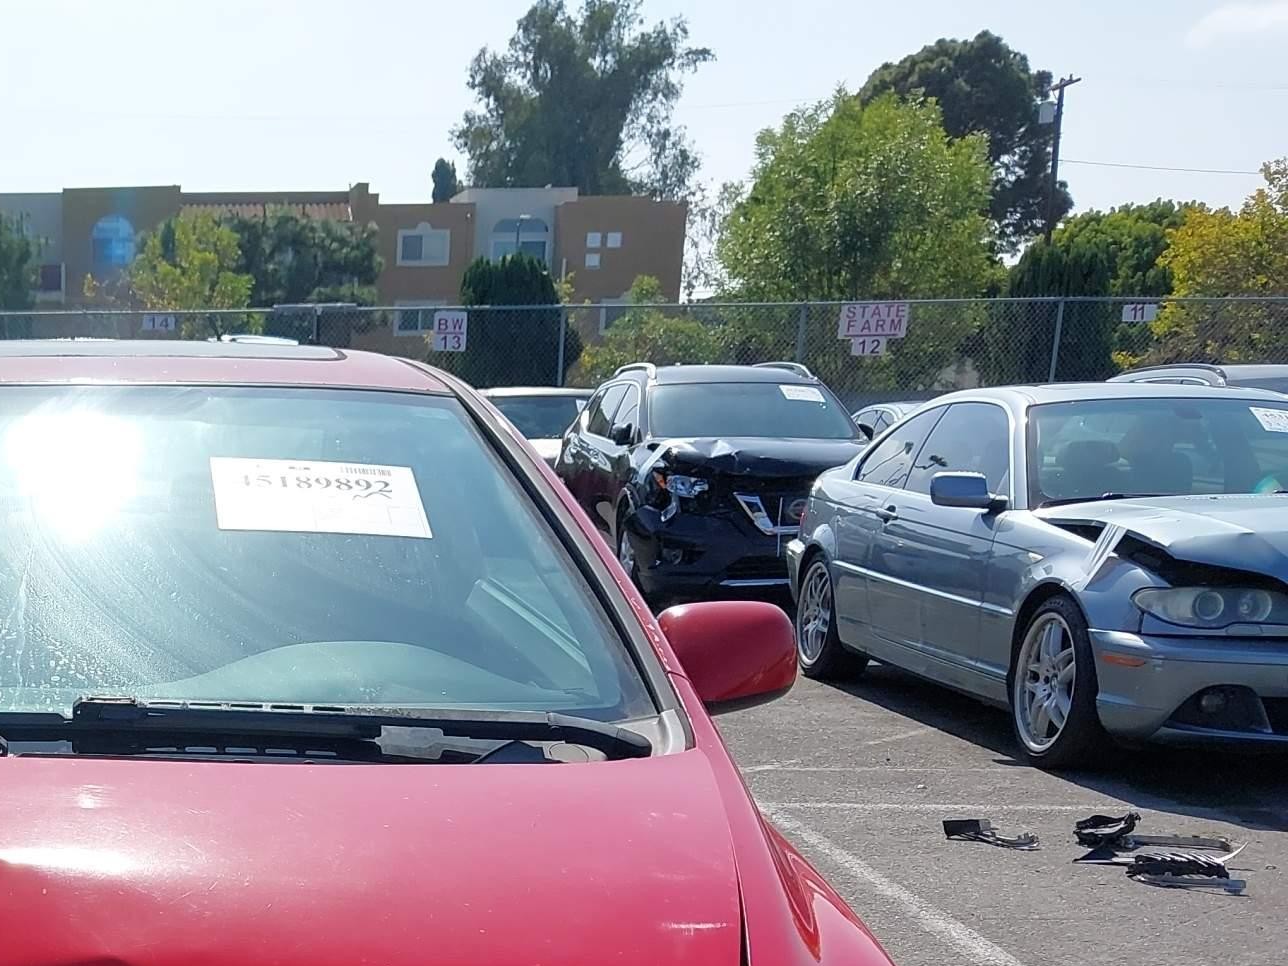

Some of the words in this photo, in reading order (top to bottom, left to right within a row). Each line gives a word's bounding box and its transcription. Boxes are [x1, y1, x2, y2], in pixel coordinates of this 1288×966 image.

[846, 304, 906, 319] STATE
[1131, 304, 1145, 321] 11
[150, 317, 169, 329] 14
[438, 318, 464, 331] BW
[847, 319, 902, 333] FARM
[441, 335, 462, 350] 13
[858, 339, 881, 354] 12
